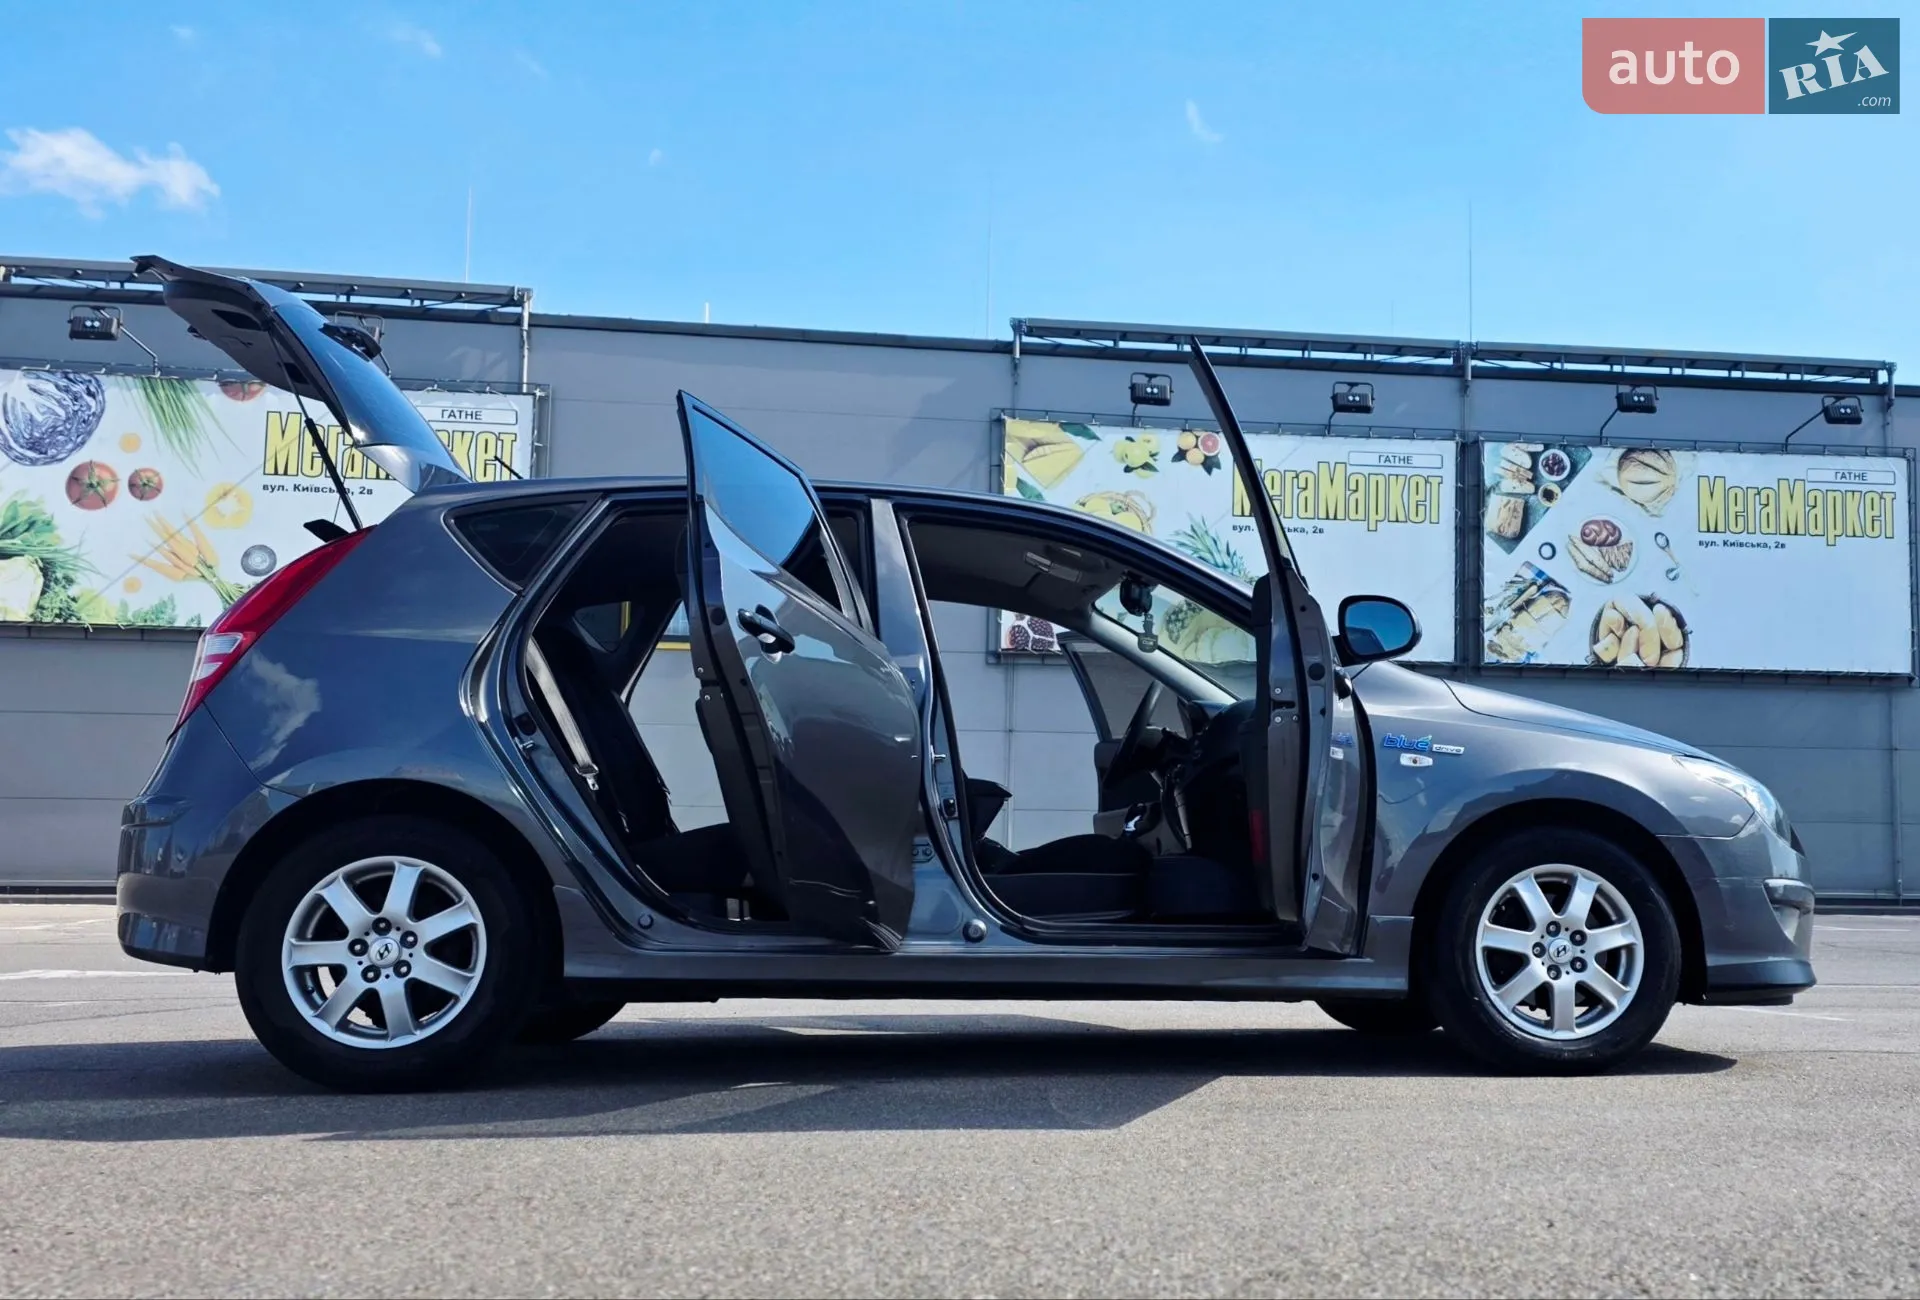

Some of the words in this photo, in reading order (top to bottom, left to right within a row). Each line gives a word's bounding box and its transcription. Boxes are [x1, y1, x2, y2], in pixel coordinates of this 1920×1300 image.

[441, 409, 483, 421] ГАТНЕ
[1378, 454, 1414, 465] ГАТНЕ
[1834, 471, 1868, 482] ГАТНЕ
[262, 484, 289, 493] вул.
[358, 486, 373, 495] 2в
[1697, 475, 1897, 546] МегаМаркет
[1232, 524, 1254, 533] вул.
[1312, 525, 1324, 534] 2в
[1698, 540, 1720, 549] вул.
[1722, 539, 1771, 550] Київська,
[1773, 541, 1786, 549] 2в
[1383, 733, 1432, 752] blue
[1434, 745, 1462, 753] drive
